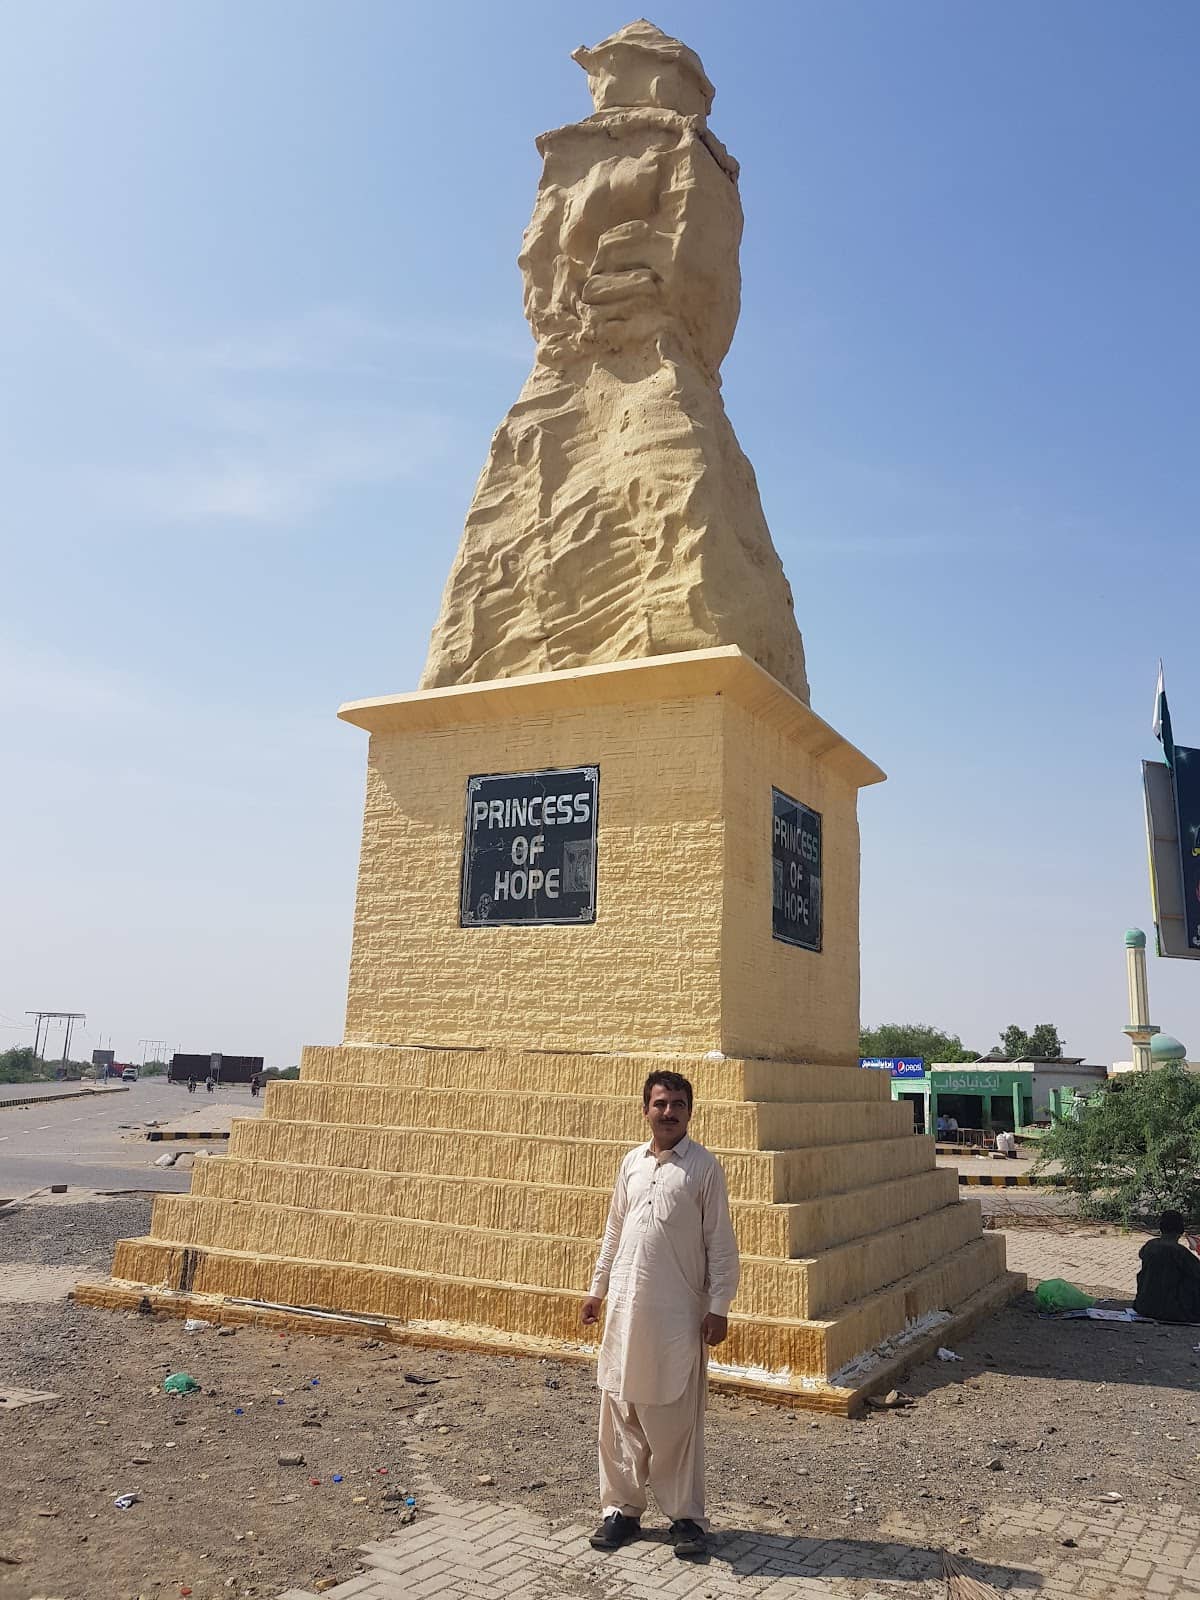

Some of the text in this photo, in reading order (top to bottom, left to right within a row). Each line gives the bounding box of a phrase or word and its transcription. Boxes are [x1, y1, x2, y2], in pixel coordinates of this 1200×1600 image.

[473, 793, 590, 830] PRINCESS
[511, 835, 545, 866] OF
[774, 815, 819, 864] PRINCESS
[494, 868, 560, 901] HOPE
[789, 861, 803, 889] OF
[784, 892, 809, 926] HOPE
[905, 1062, 922, 1073] pepsi
[966, 1074, 979, 1091] نیا
[979, 1073, 1000, 1091] ایک
